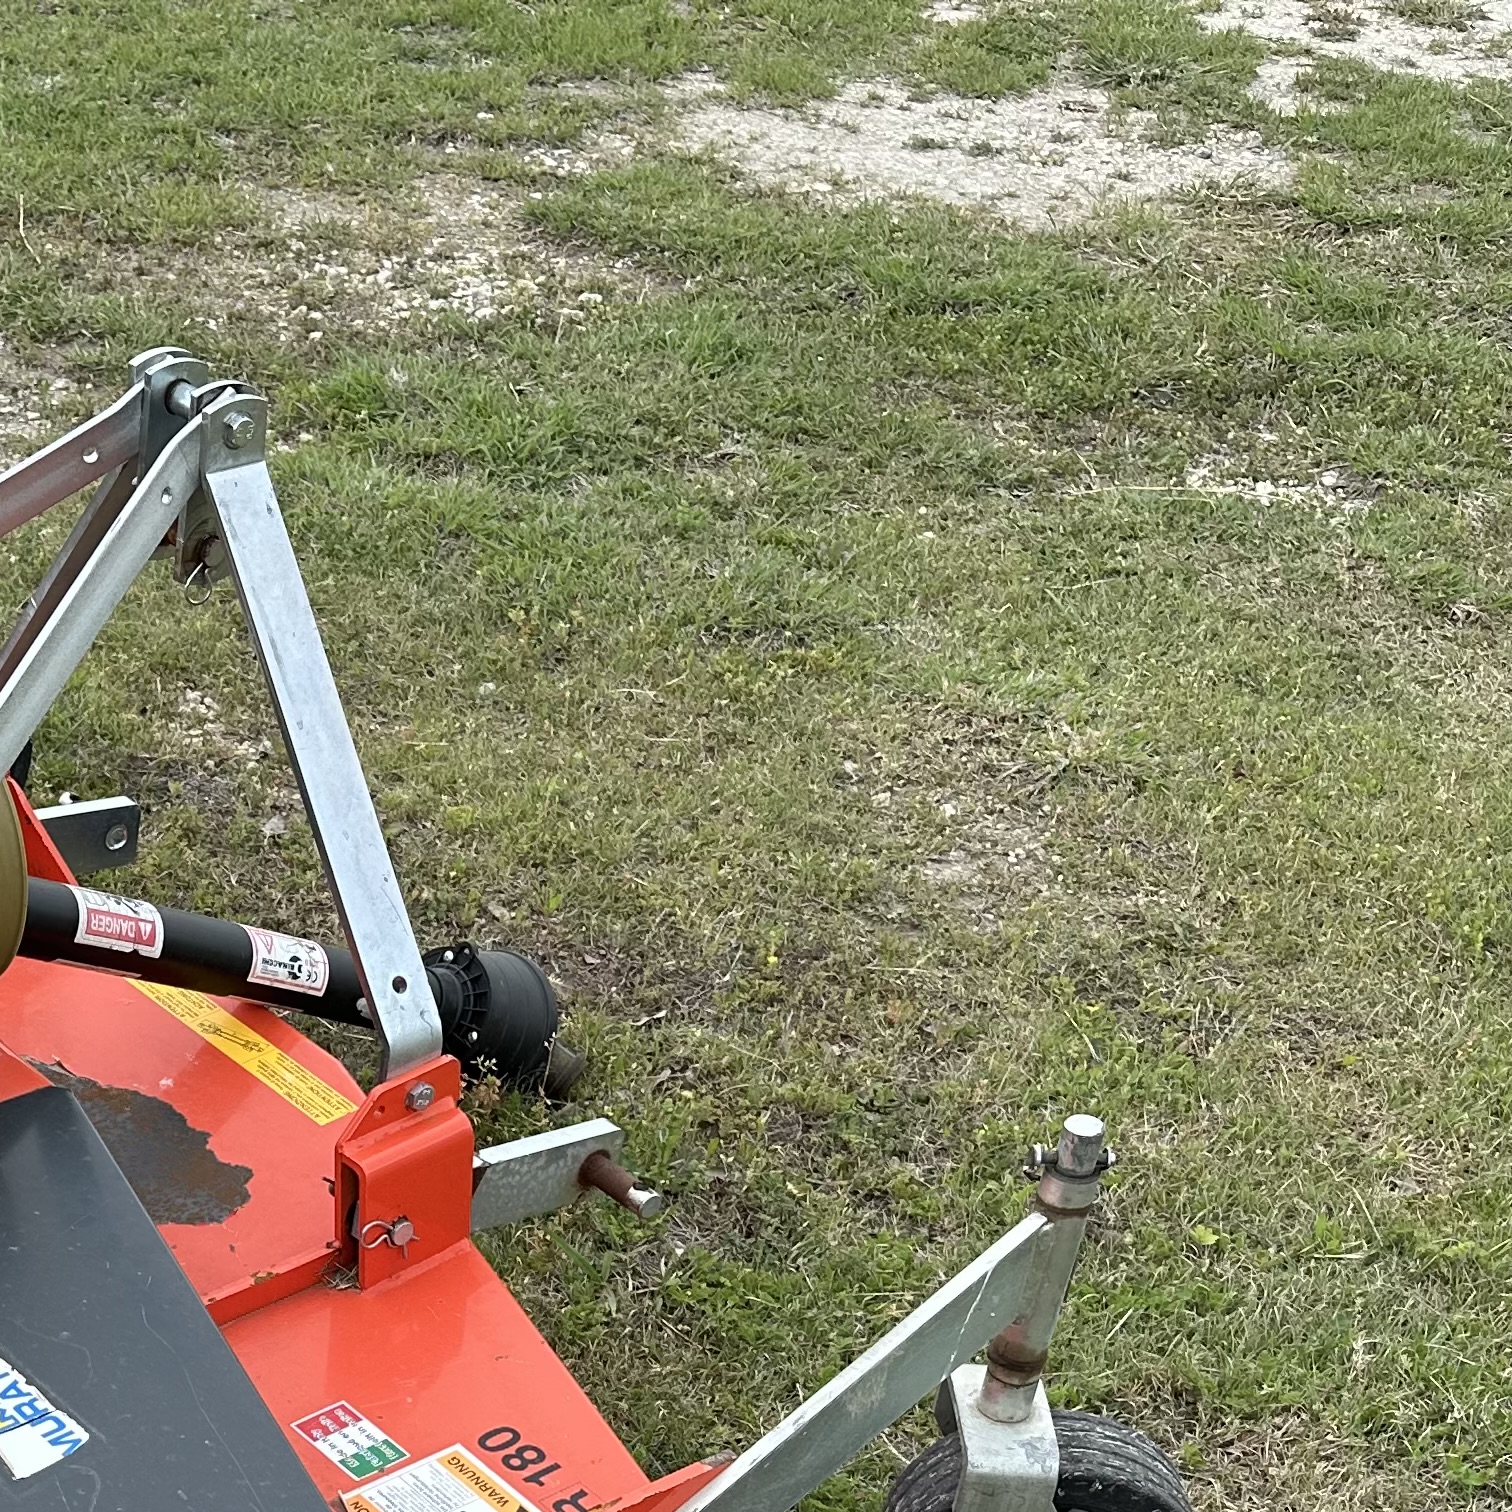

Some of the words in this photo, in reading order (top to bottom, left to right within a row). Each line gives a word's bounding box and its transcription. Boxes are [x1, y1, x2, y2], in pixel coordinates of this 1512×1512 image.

[90, 912, 137, 939] DANGER
[446, 1455, 510, 1508] WARNUNG
[477, 1426, 562, 1487] 180
